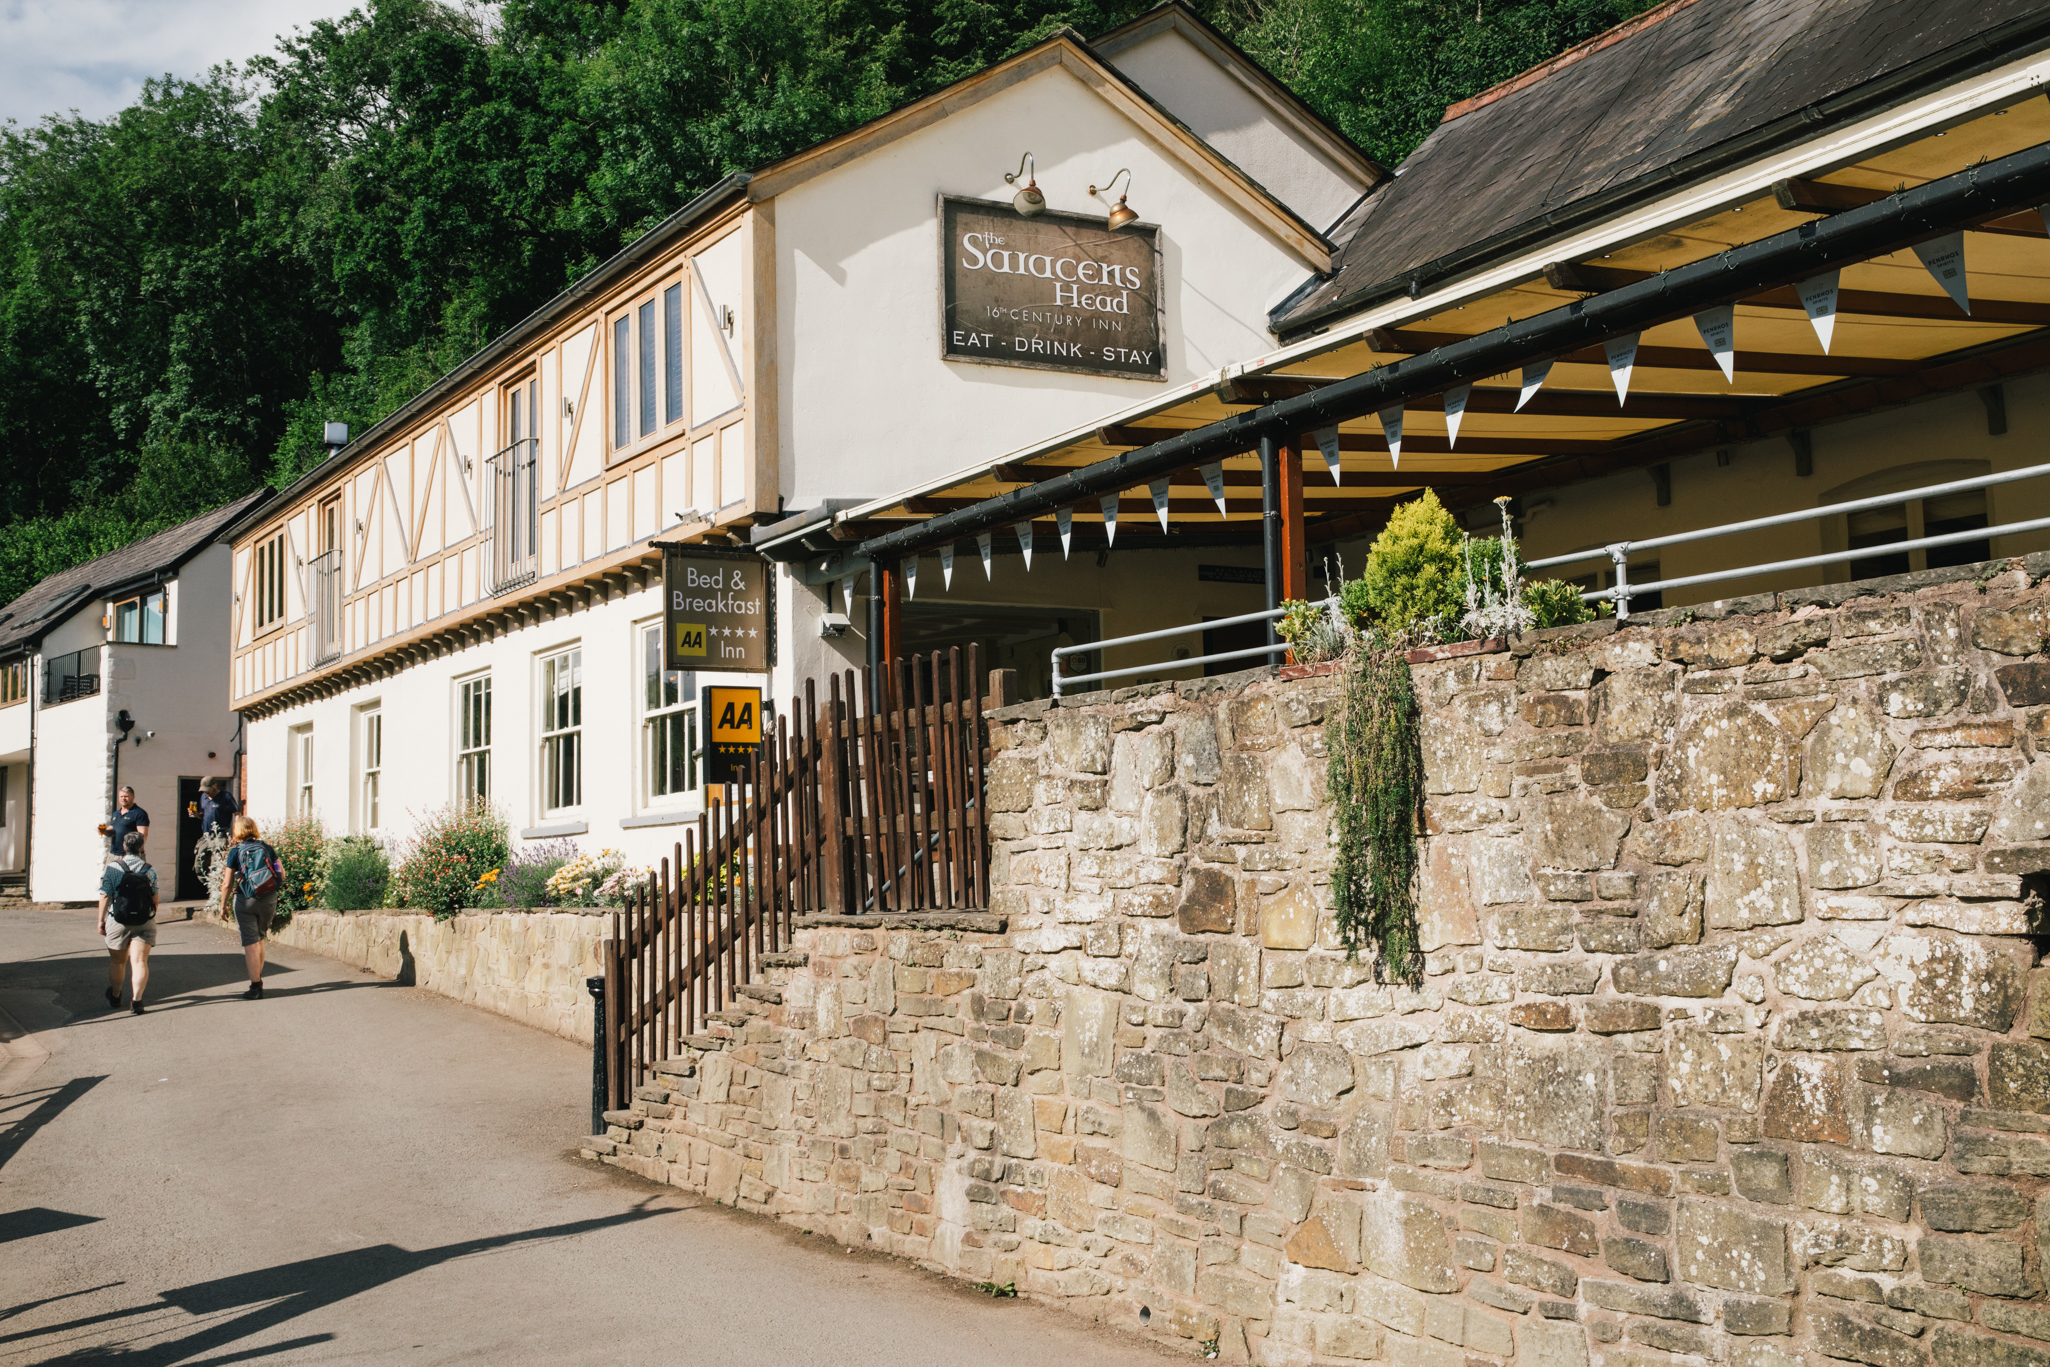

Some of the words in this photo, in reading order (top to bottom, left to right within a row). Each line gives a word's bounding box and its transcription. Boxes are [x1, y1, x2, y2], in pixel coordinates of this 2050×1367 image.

[962, 232, 1141, 290] Saracens
[1928, 250, 1959, 266] PENRHOS
[1053, 281, 1130, 315] Head
[1805, 288, 1834, 302] PENRHOS
[1010, 308, 1082, 327] CENTURY
[1092, 318, 1122, 332] INN
[1703, 322, 1729, 335] PENRHOS
[953, 330, 994, 348] EAT
[1015, 337, 1083, 358] DRINK
[1102, 347, 1153, 365] STAY
[1610, 349, 1634, 360] PENRHOS
[687, 567, 723, 589] Bed
[730, 570, 746, 590] &
[673, 590, 761, 615] Breakfast
[681, 631, 702, 648] AA
[720, 640, 745, 659] Inn
[717, 702, 753, 730] AA
